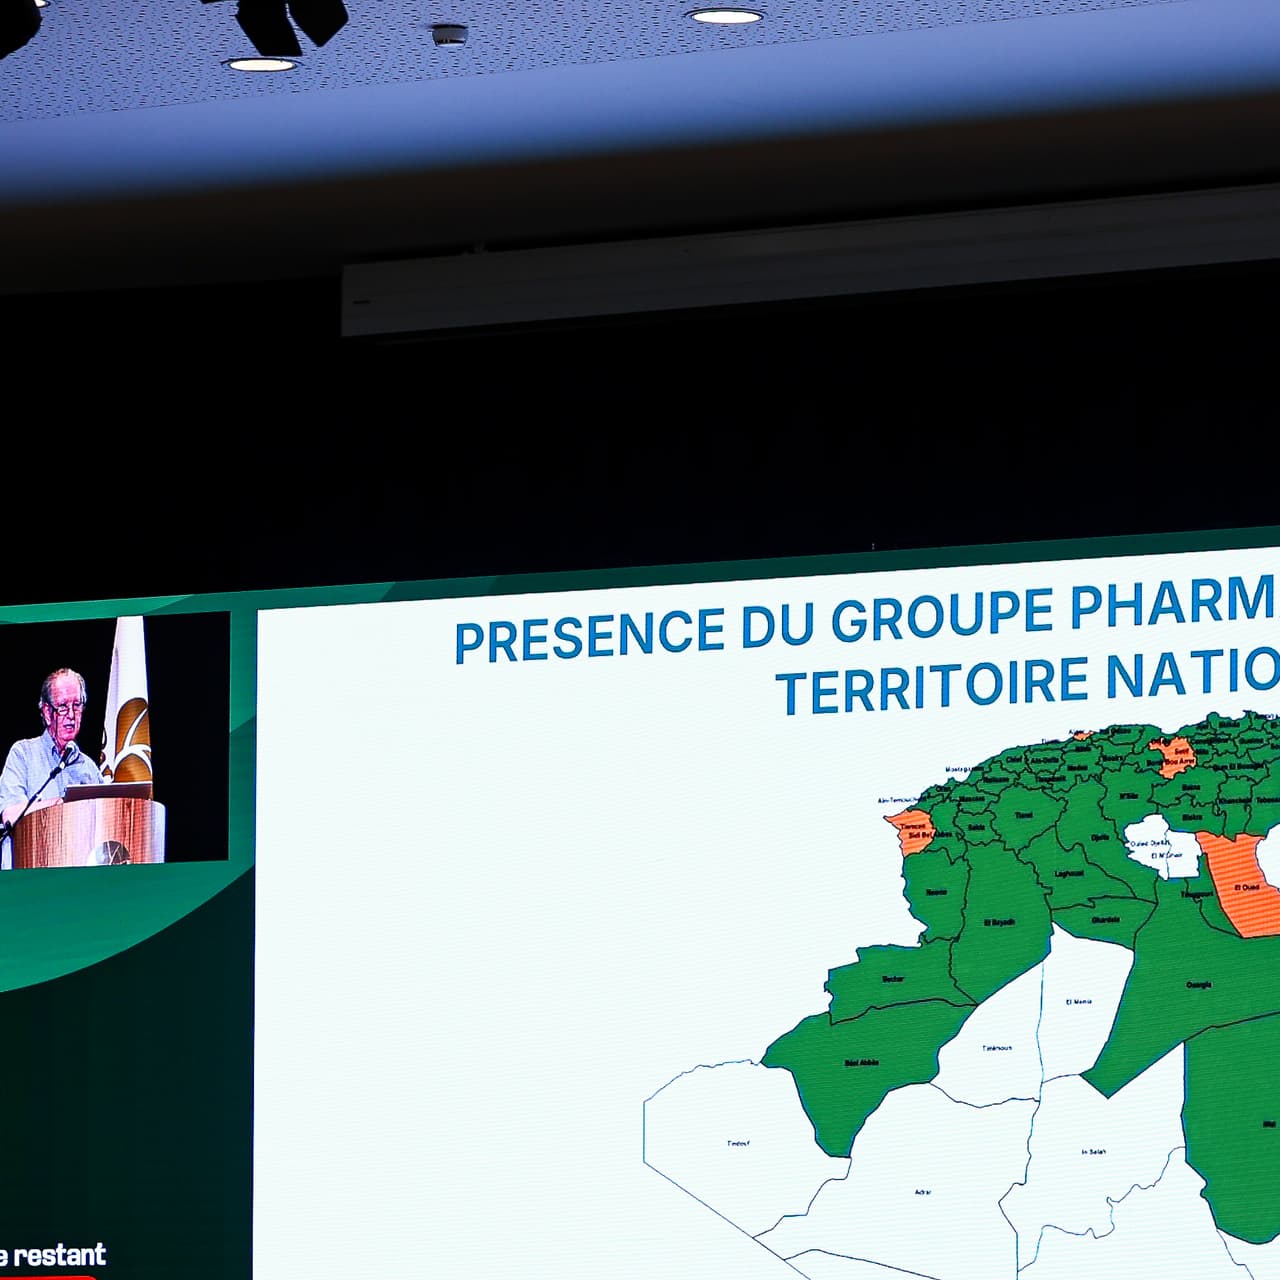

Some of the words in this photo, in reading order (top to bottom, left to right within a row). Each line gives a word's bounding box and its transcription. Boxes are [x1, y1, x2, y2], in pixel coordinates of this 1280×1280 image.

[455, 607, 725, 665] PRESENCE
[742, 602, 814, 649] DU
[831, 587, 1053, 644] GROUPE
[775, 656, 1089, 716] TERRITOIRE
[14, 1242, 107, 1267] restant
